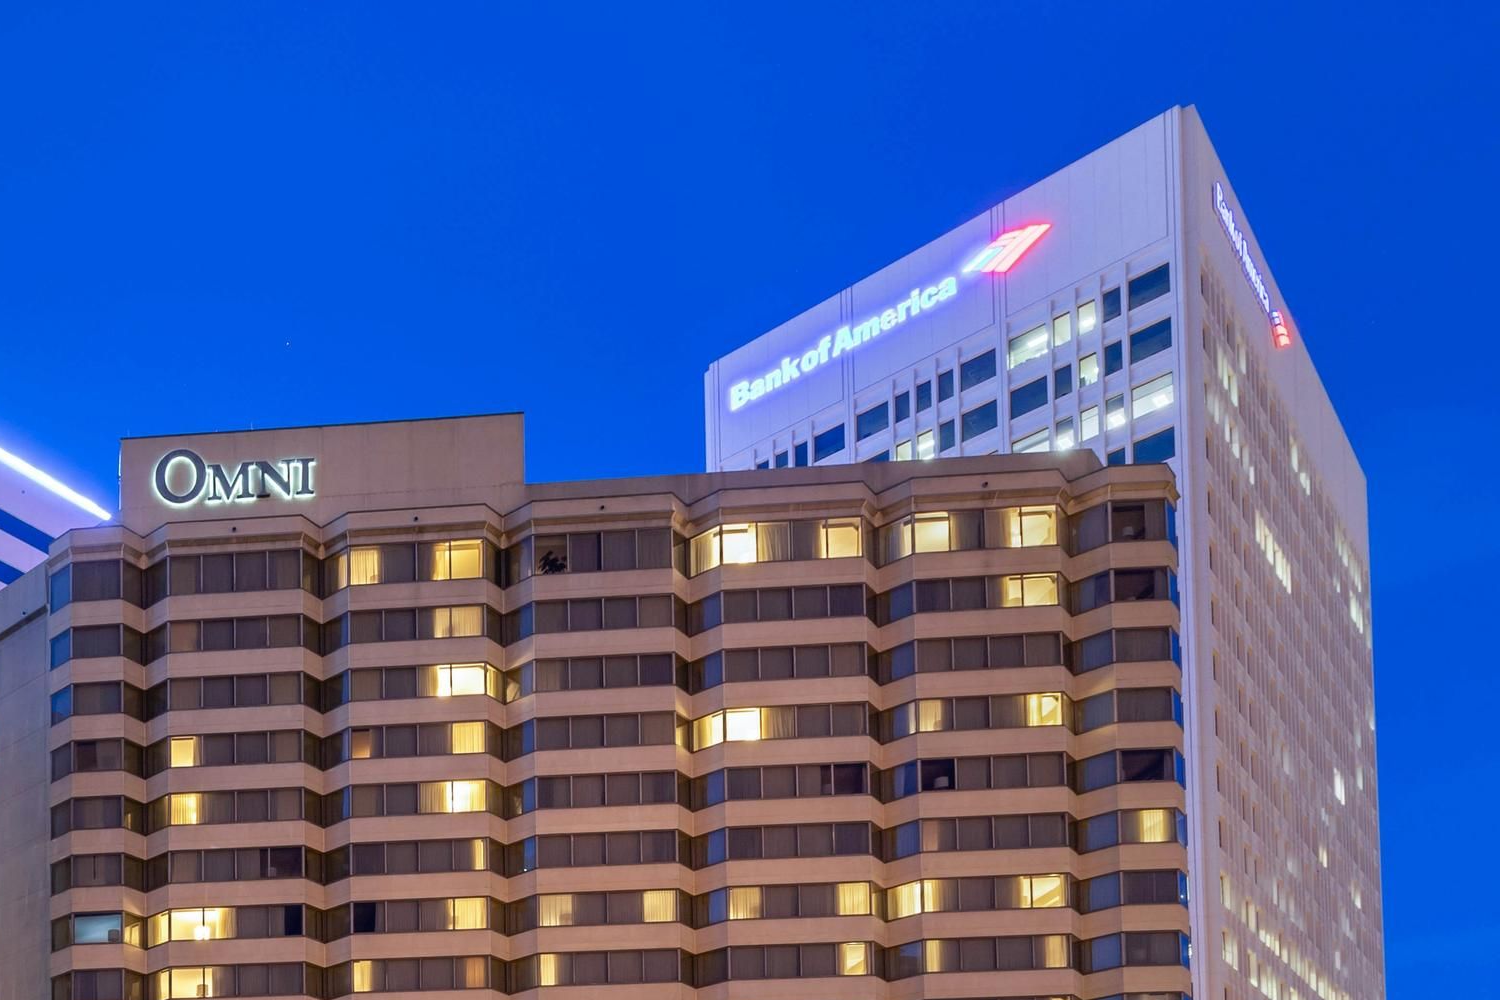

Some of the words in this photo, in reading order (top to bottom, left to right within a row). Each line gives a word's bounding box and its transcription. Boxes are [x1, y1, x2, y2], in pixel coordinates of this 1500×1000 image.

[729, 356, 801, 412] Bank
[800, 335, 833, 373] of
[831, 276, 958, 358] America
[154, 448, 316, 504] OMNI
